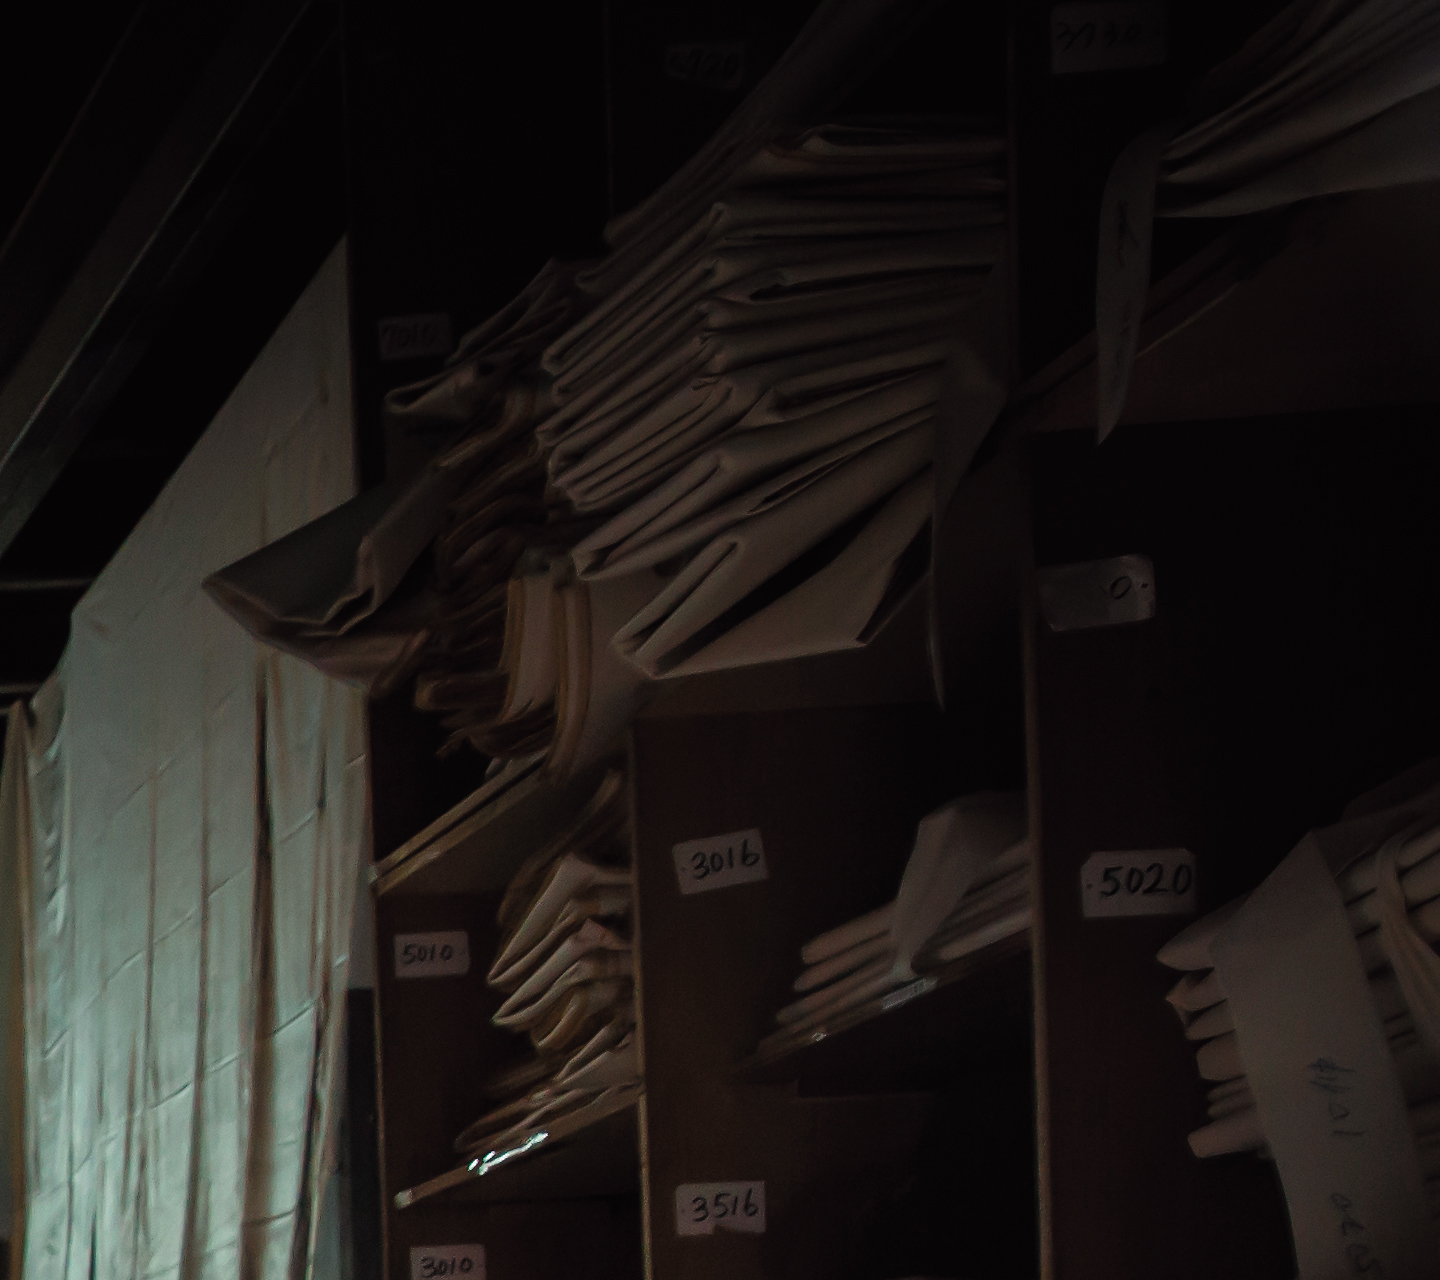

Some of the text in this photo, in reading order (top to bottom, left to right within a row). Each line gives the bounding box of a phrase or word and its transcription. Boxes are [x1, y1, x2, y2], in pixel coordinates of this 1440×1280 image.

[691, 839, 760, 879] 3016
[1100, 862, 1193, 896] 5020
[402, 942, 454, 965] 5010
[692, 1187, 760, 1222] 3516
[421, 1256, 473, 1278] 3010
